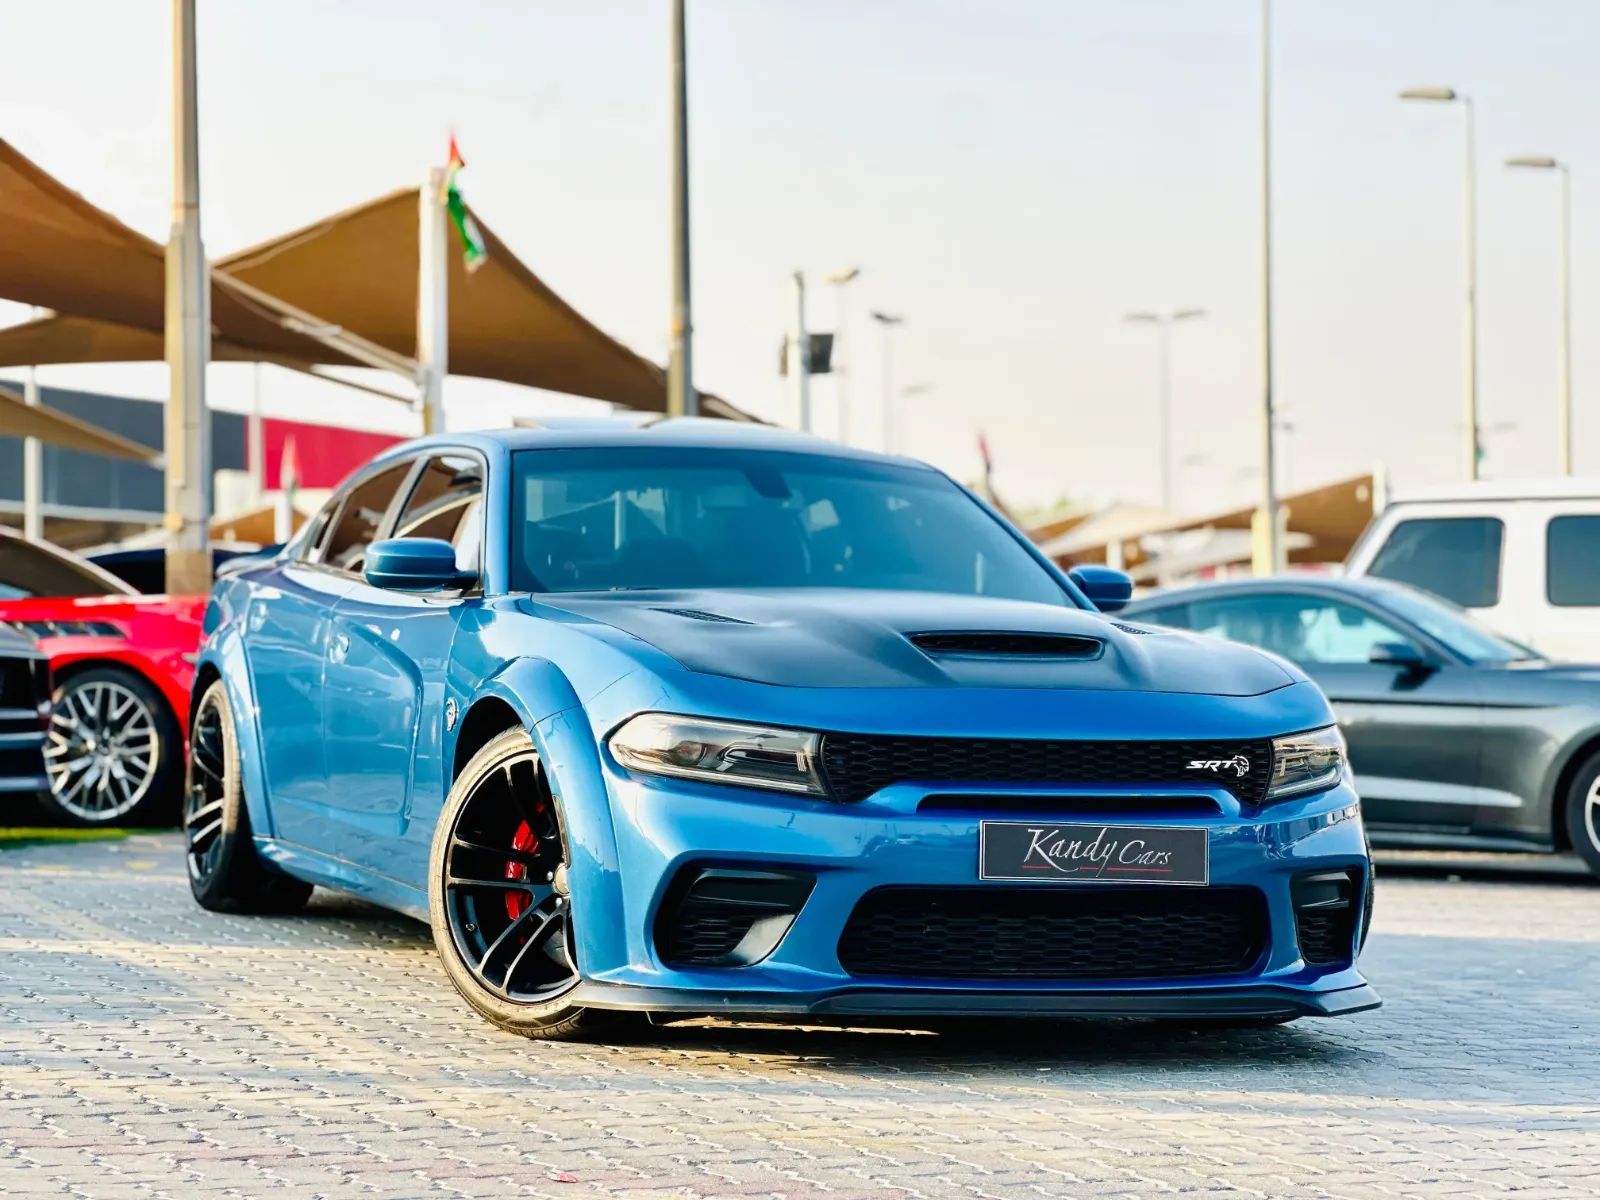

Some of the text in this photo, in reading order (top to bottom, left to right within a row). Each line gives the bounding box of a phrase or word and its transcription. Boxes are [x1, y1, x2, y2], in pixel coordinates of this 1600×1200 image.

[1186, 760, 1237, 772] SRT
[1023, 827, 1172, 878] Kandy Cars
